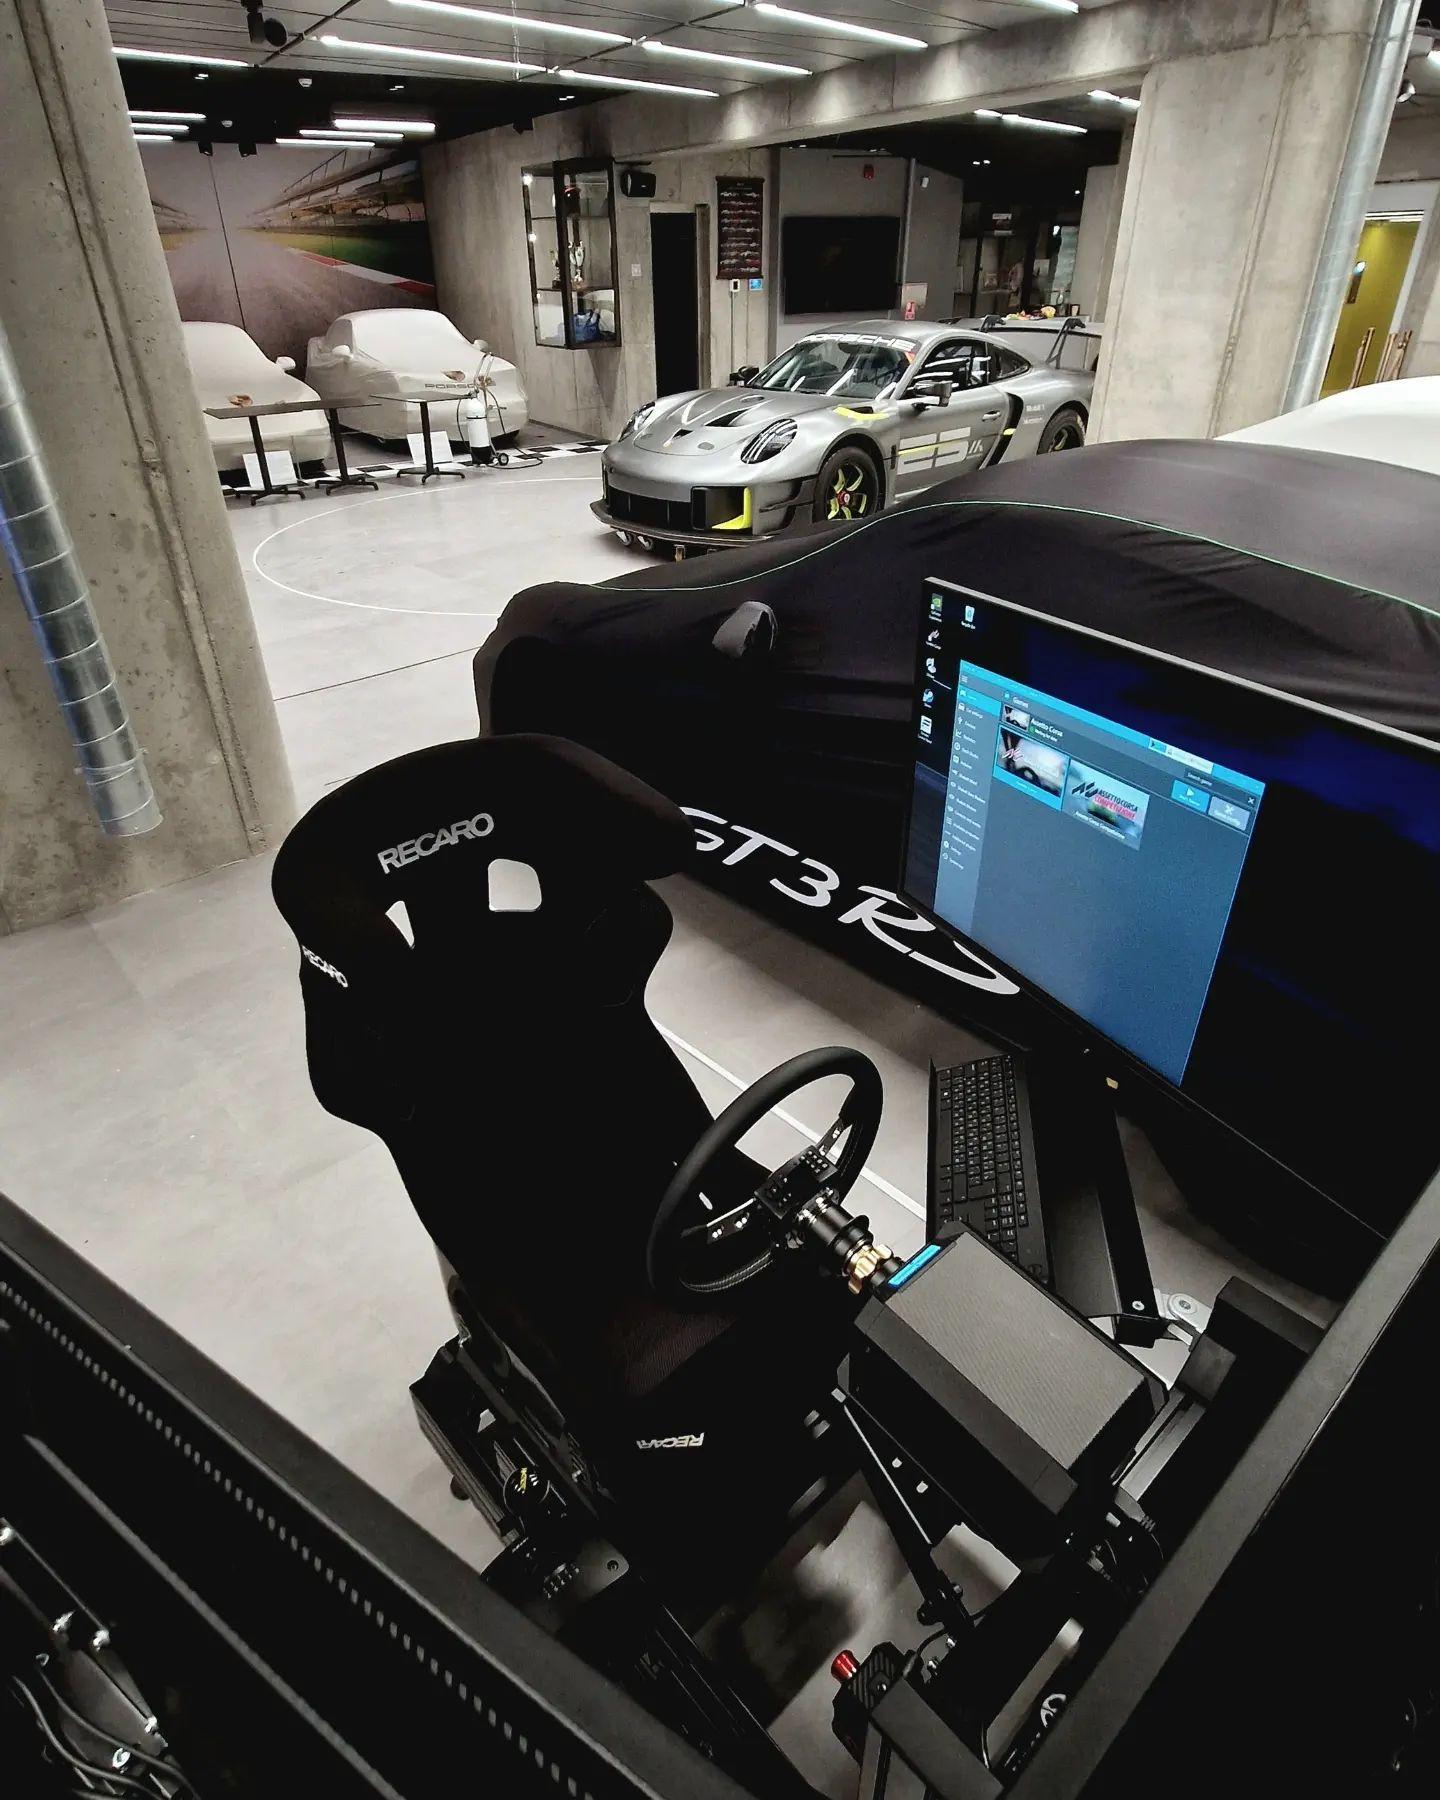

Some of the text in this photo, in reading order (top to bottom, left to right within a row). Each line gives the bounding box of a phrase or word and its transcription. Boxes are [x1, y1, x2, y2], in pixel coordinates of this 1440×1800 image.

[1030, 717, 1063, 737] Assetto Corsa
[1097, 788, 1138, 811] ASSETTO CORSA
[377, 813, 495, 874] RECARO
[679, 806, 840, 907] GT3
[636, 1432, 704, 1449] RECAR
